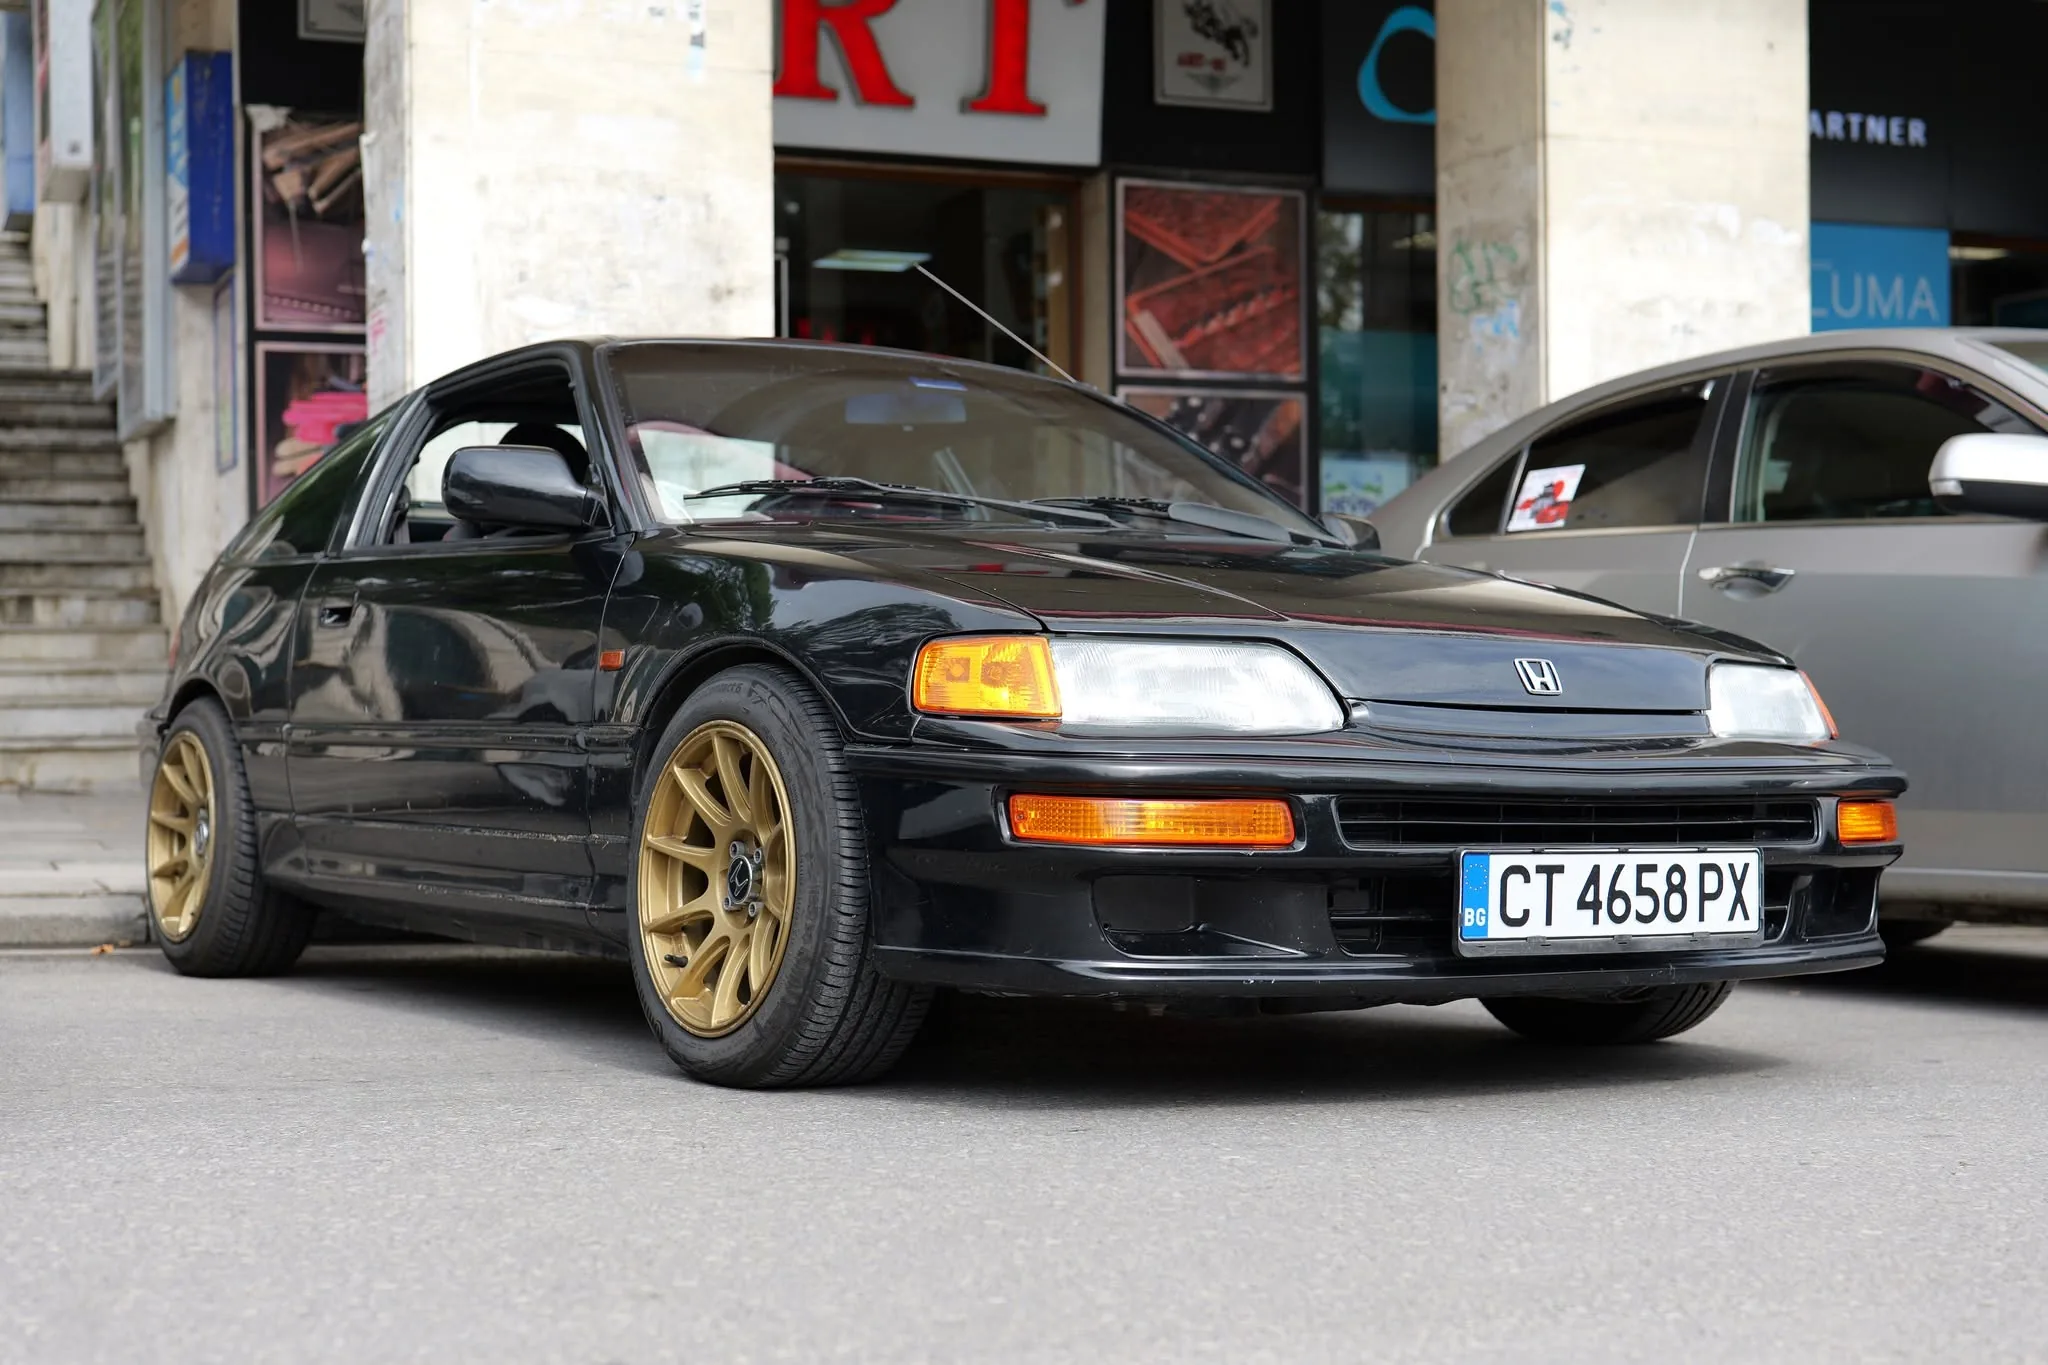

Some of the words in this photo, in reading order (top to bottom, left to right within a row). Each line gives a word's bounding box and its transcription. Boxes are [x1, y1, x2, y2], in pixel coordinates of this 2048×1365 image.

[1499, 864, 1565, 927] CT
[1576, 863, 1688, 925] 4658
[1699, 862, 1750, 922] PX
[1464, 908, 1486, 926] BG
